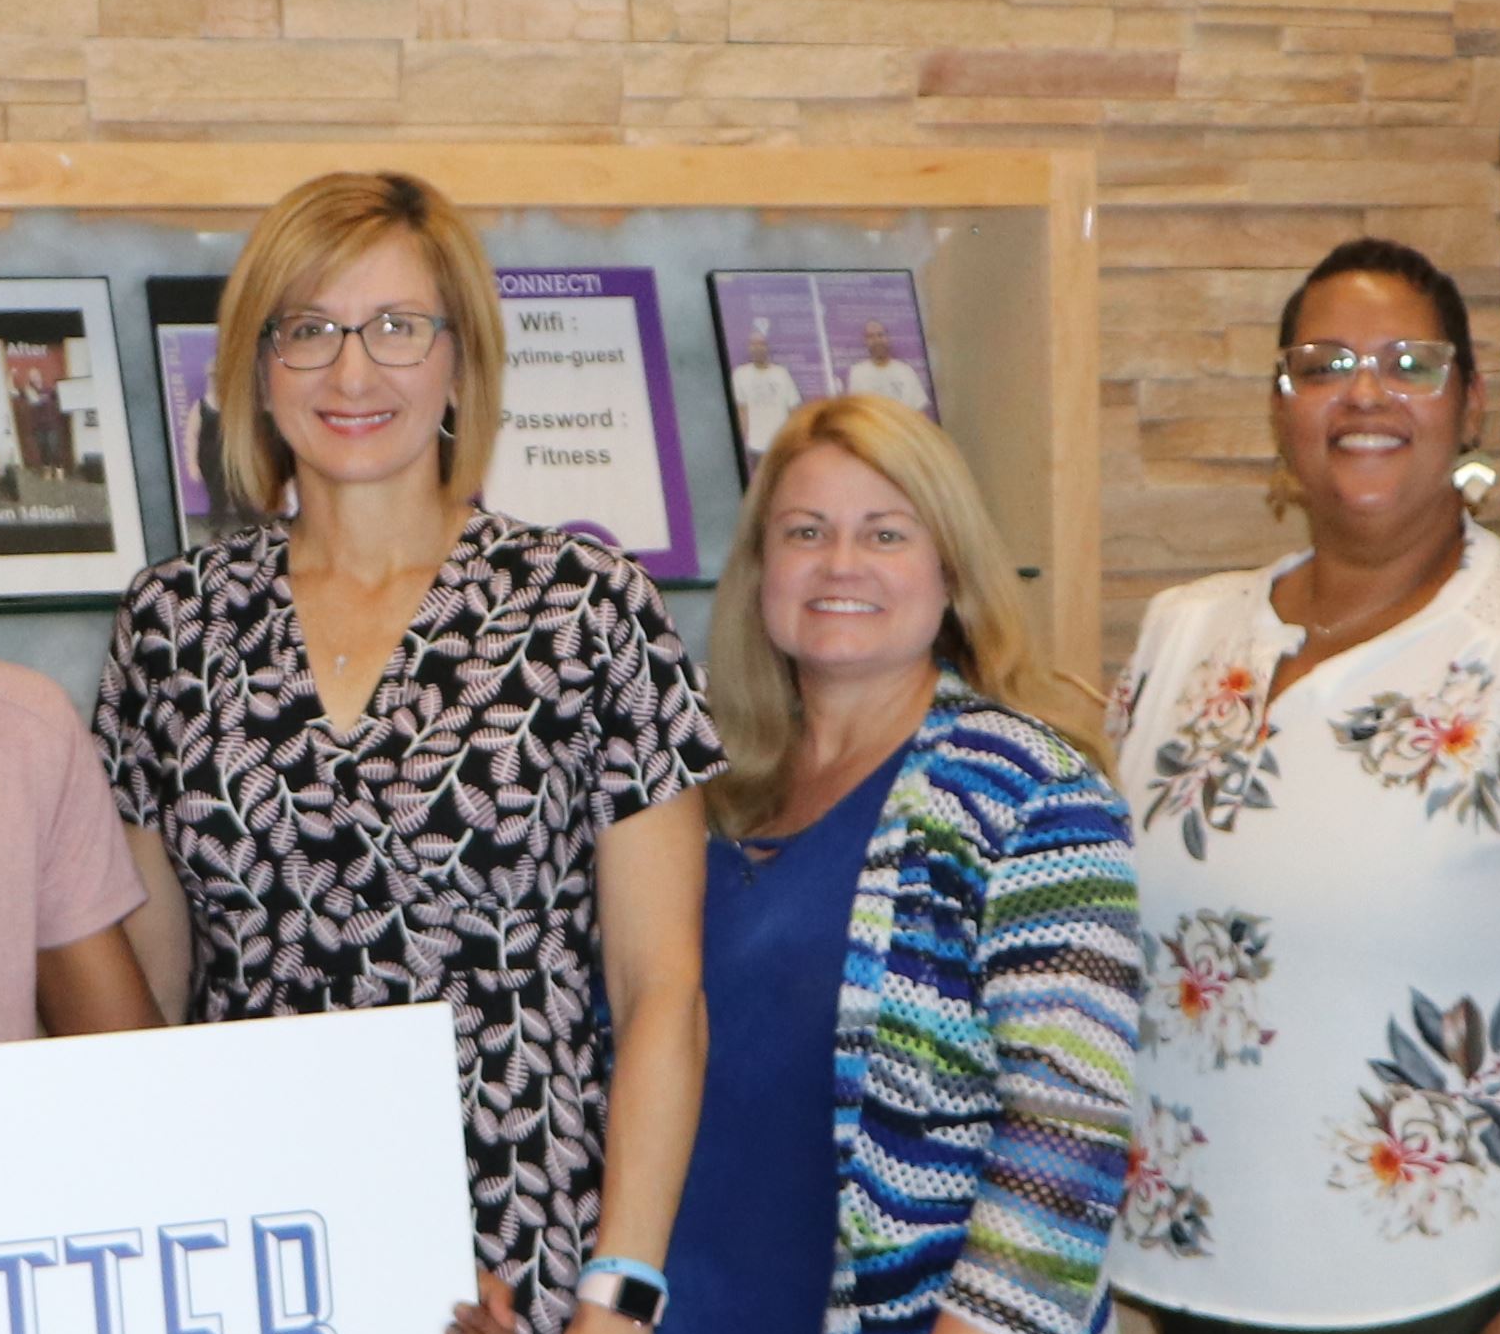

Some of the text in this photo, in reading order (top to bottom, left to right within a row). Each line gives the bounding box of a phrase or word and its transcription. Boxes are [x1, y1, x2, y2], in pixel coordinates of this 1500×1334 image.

[518, 310, 565, 332] Wifi
[506, 347, 625, 367] ytime-guest
[501, 407, 613, 429] Password
[525, 446, 612, 465] Fitness
